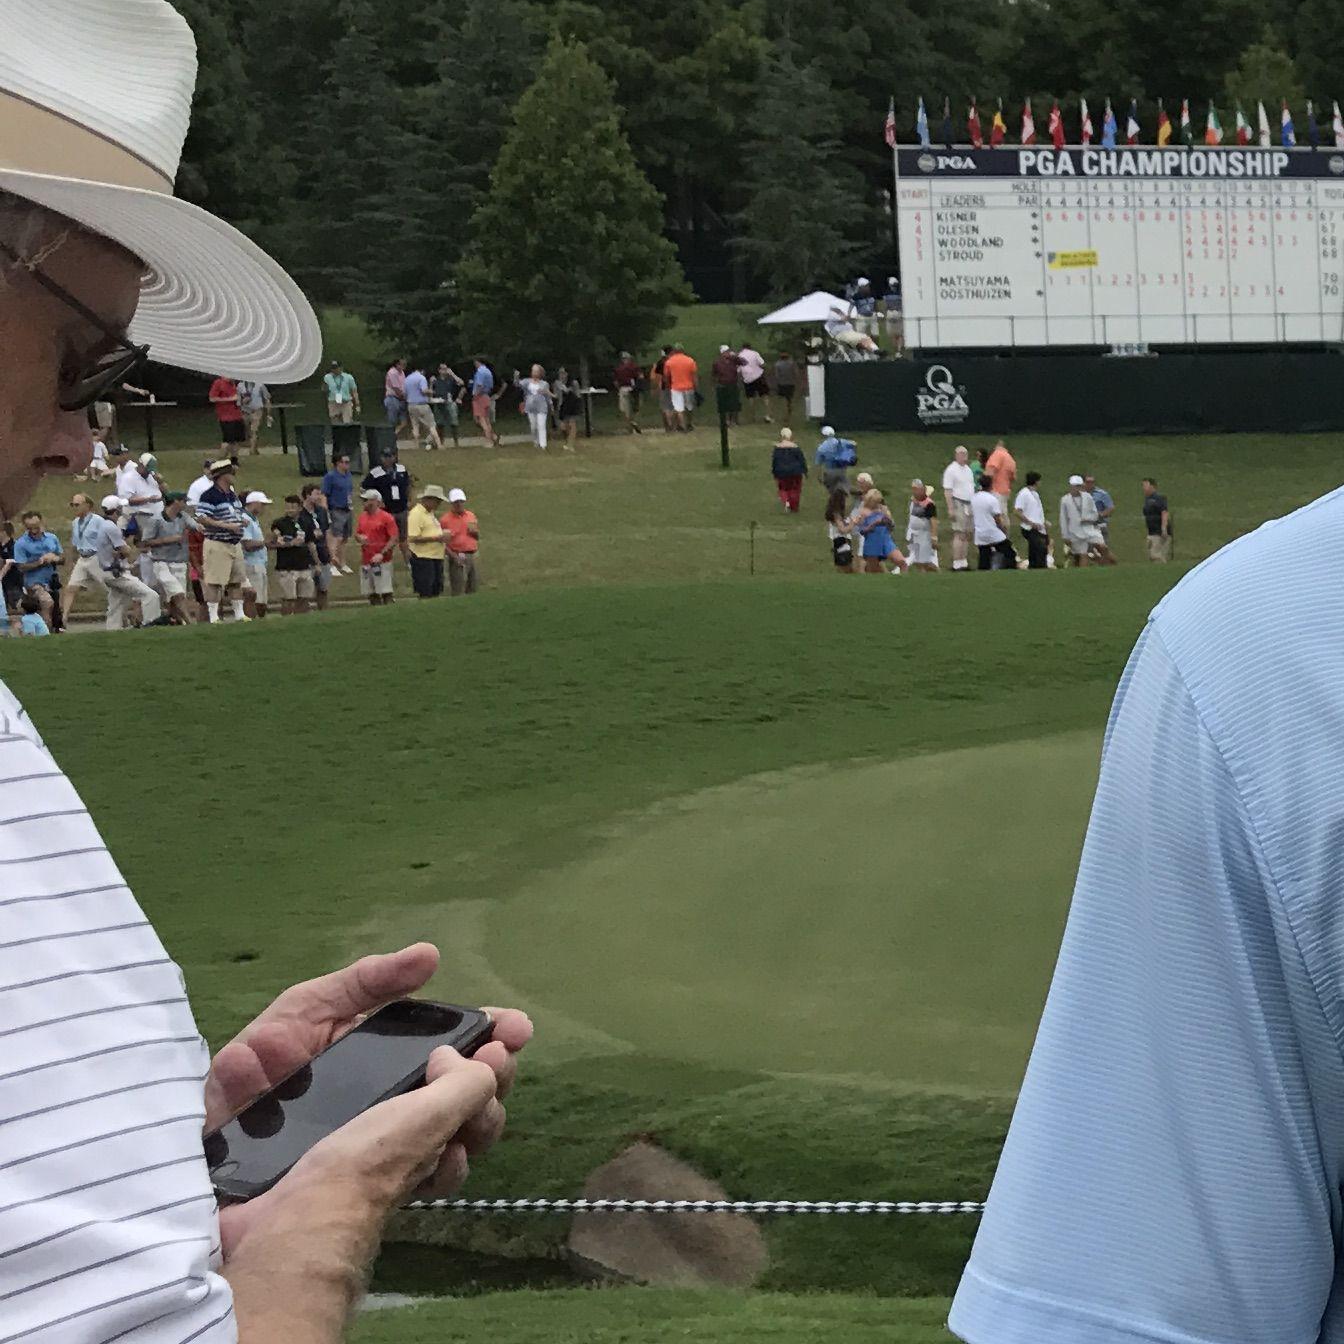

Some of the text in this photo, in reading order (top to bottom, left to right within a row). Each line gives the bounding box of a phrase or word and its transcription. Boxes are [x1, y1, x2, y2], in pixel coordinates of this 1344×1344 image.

[937, 156, 977, 170] PGA
[1019, 151, 1287, 175] PGA CHAMPIONSHIP
[937, 212, 977, 222] KISNER
[938, 224, 979, 234] OLESEN
[938, 236, 1003, 248] WOODLAND
[939, 249, 984, 261] STROUD
[940, 275, 1010, 286] MATSUYAMA
[941, 288, 1011, 299] OOSTHUIZEN
[916, 394, 968, 410] PGA
